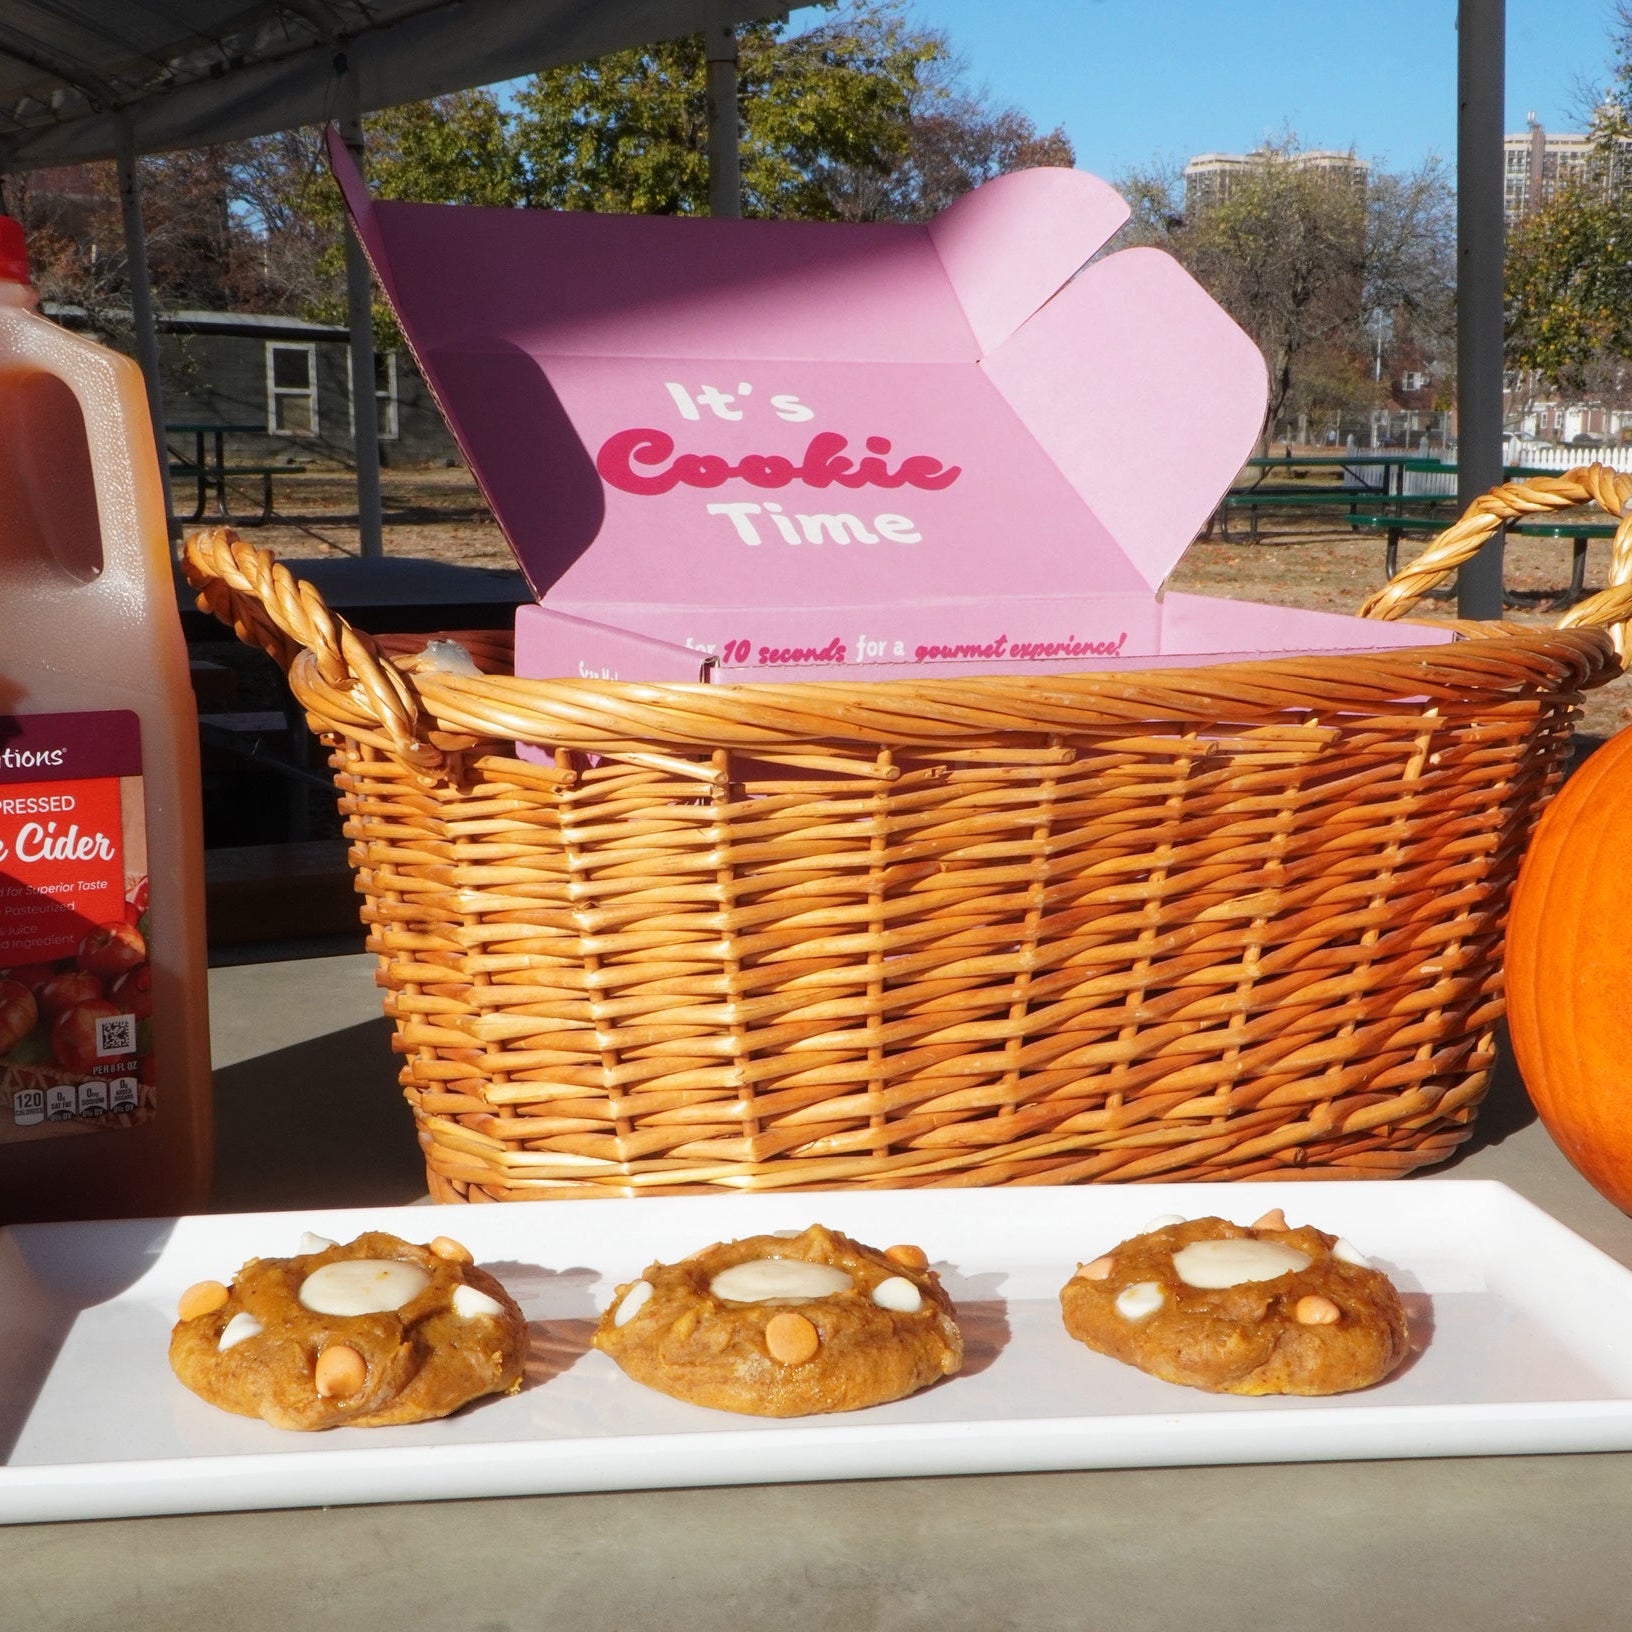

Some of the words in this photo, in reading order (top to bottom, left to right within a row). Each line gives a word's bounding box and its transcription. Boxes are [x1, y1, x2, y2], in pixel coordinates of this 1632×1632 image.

[597, 428, 962, 496] Cookie
[706, 502, 923, 546] Time
[723, 639, 752, 664] 10
[758, 637, 847, 664] seconds
[856, 634, 886, 663] for
[893, 640, 905, 657] a
[914, 634, 1008, 663] gourmet
[1009, 632, 1128, 661] experience!
[0, 748, 63, 768] tions
[15, 822, 115, 863] Cider
[26, 882, 74, 896] Superior
[77, 879, 108, 891] Taste
[5, 901, 75, 916] Pasteurized
[92, 1064, 110, 1075] PER
[117, 1062, 126, 1072] FL
[127, 1061, 138, 1070] OZ
[16, 1093, 42, 1109] 120
